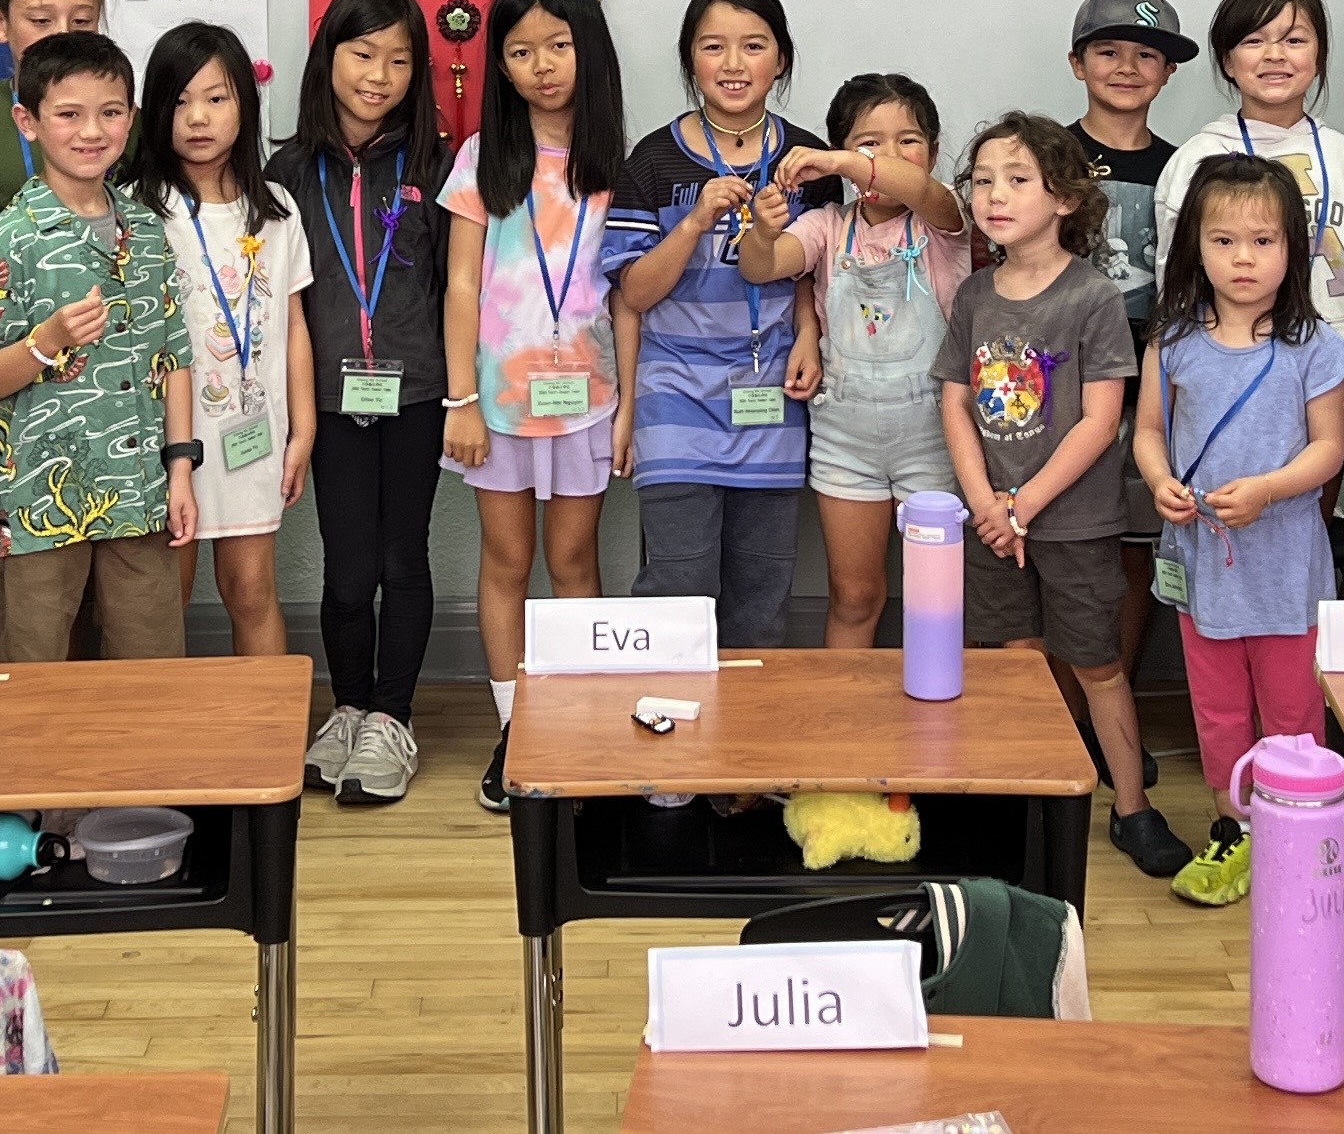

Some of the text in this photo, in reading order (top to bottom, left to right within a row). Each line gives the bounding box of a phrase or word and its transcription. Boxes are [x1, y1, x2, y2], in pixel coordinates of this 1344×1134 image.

[671, 182, 699, 207] Full
[592, 622, 651, 652] Eva
[728, 978, 844, 1030] Julia
